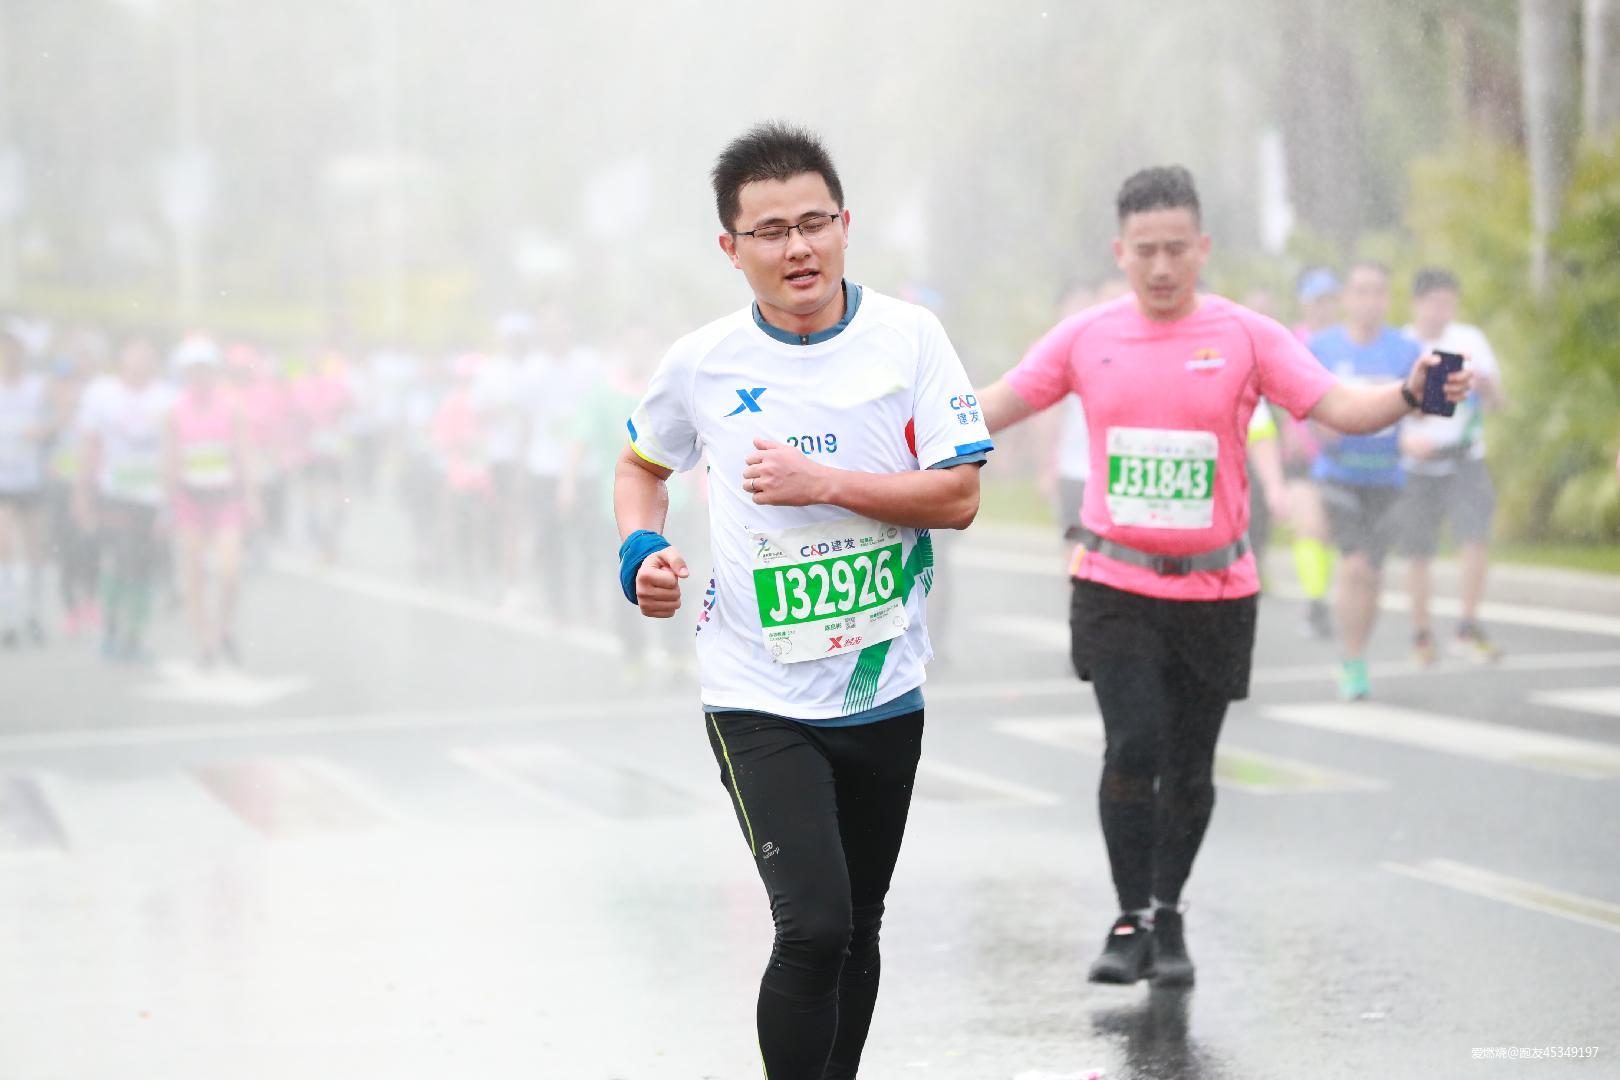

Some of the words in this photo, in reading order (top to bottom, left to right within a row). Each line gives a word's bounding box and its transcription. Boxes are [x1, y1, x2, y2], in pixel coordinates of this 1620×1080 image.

[950, 394, 977, 410] C&D
[956, 409, 980, 425] 建发
[786, 433, 838, 455] 2019
[1112, 458, 1209, 498] J31843
[800, 542, 830, 558] C&D
[830, 537, 856, 553] 建发
[769, 550, 895, 623] J32926
